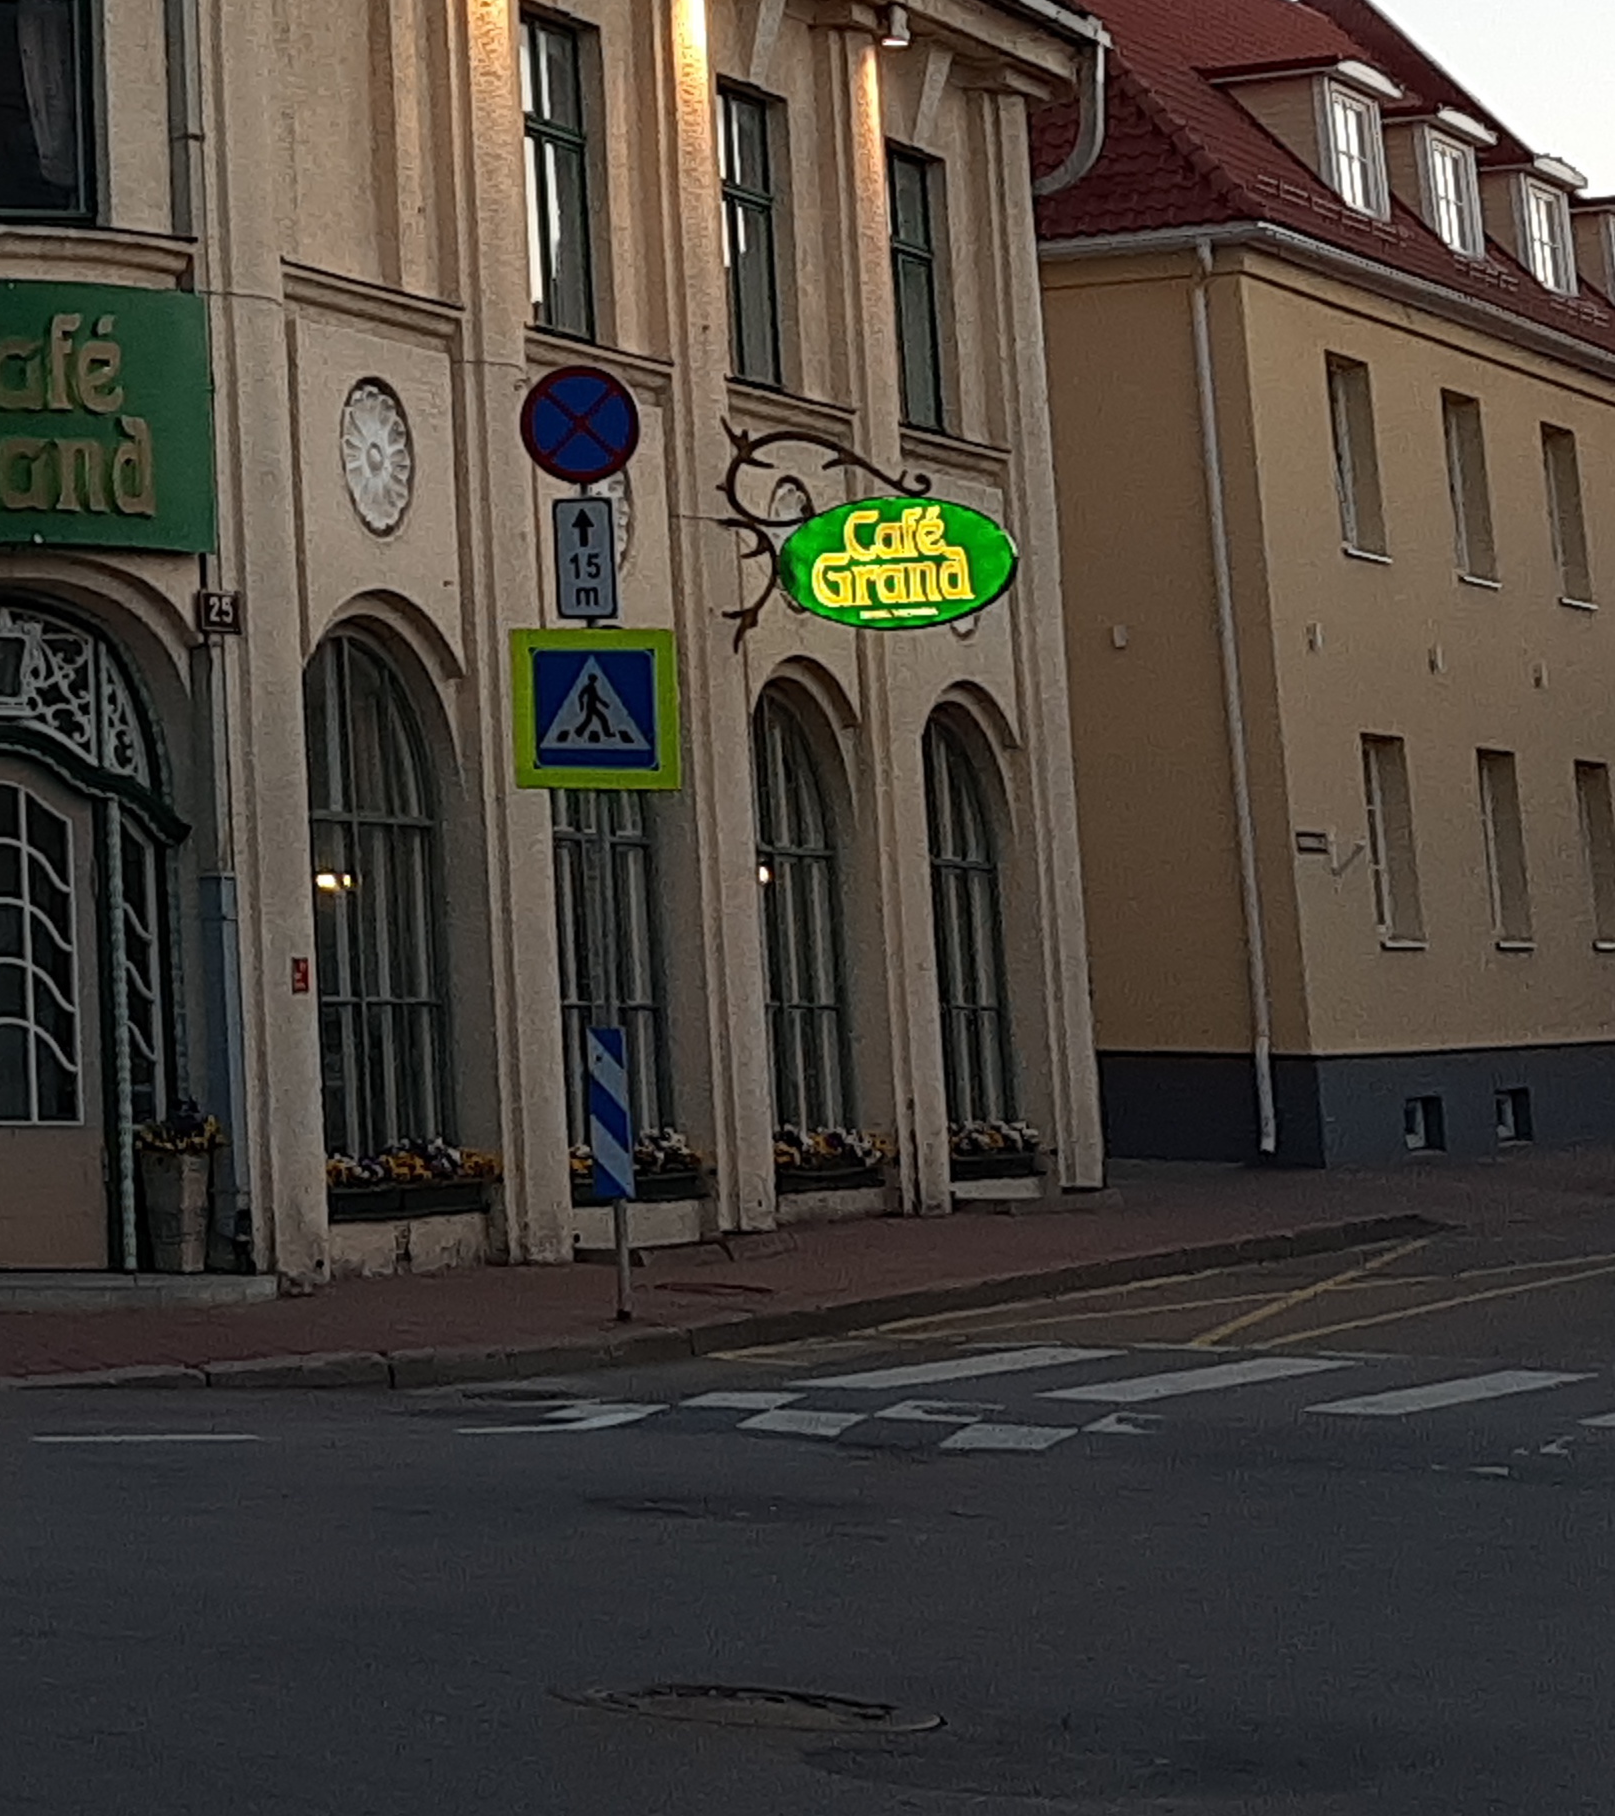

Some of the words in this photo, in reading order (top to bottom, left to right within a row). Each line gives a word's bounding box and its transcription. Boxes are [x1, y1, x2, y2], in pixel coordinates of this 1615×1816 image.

[843, 504, 946, 561] Café
[569, 553, 600, 580] 15
[811, 546, 976, 608] Grand
[208, 595, 234, 624] 25
[575, 586, 599, 607] m
